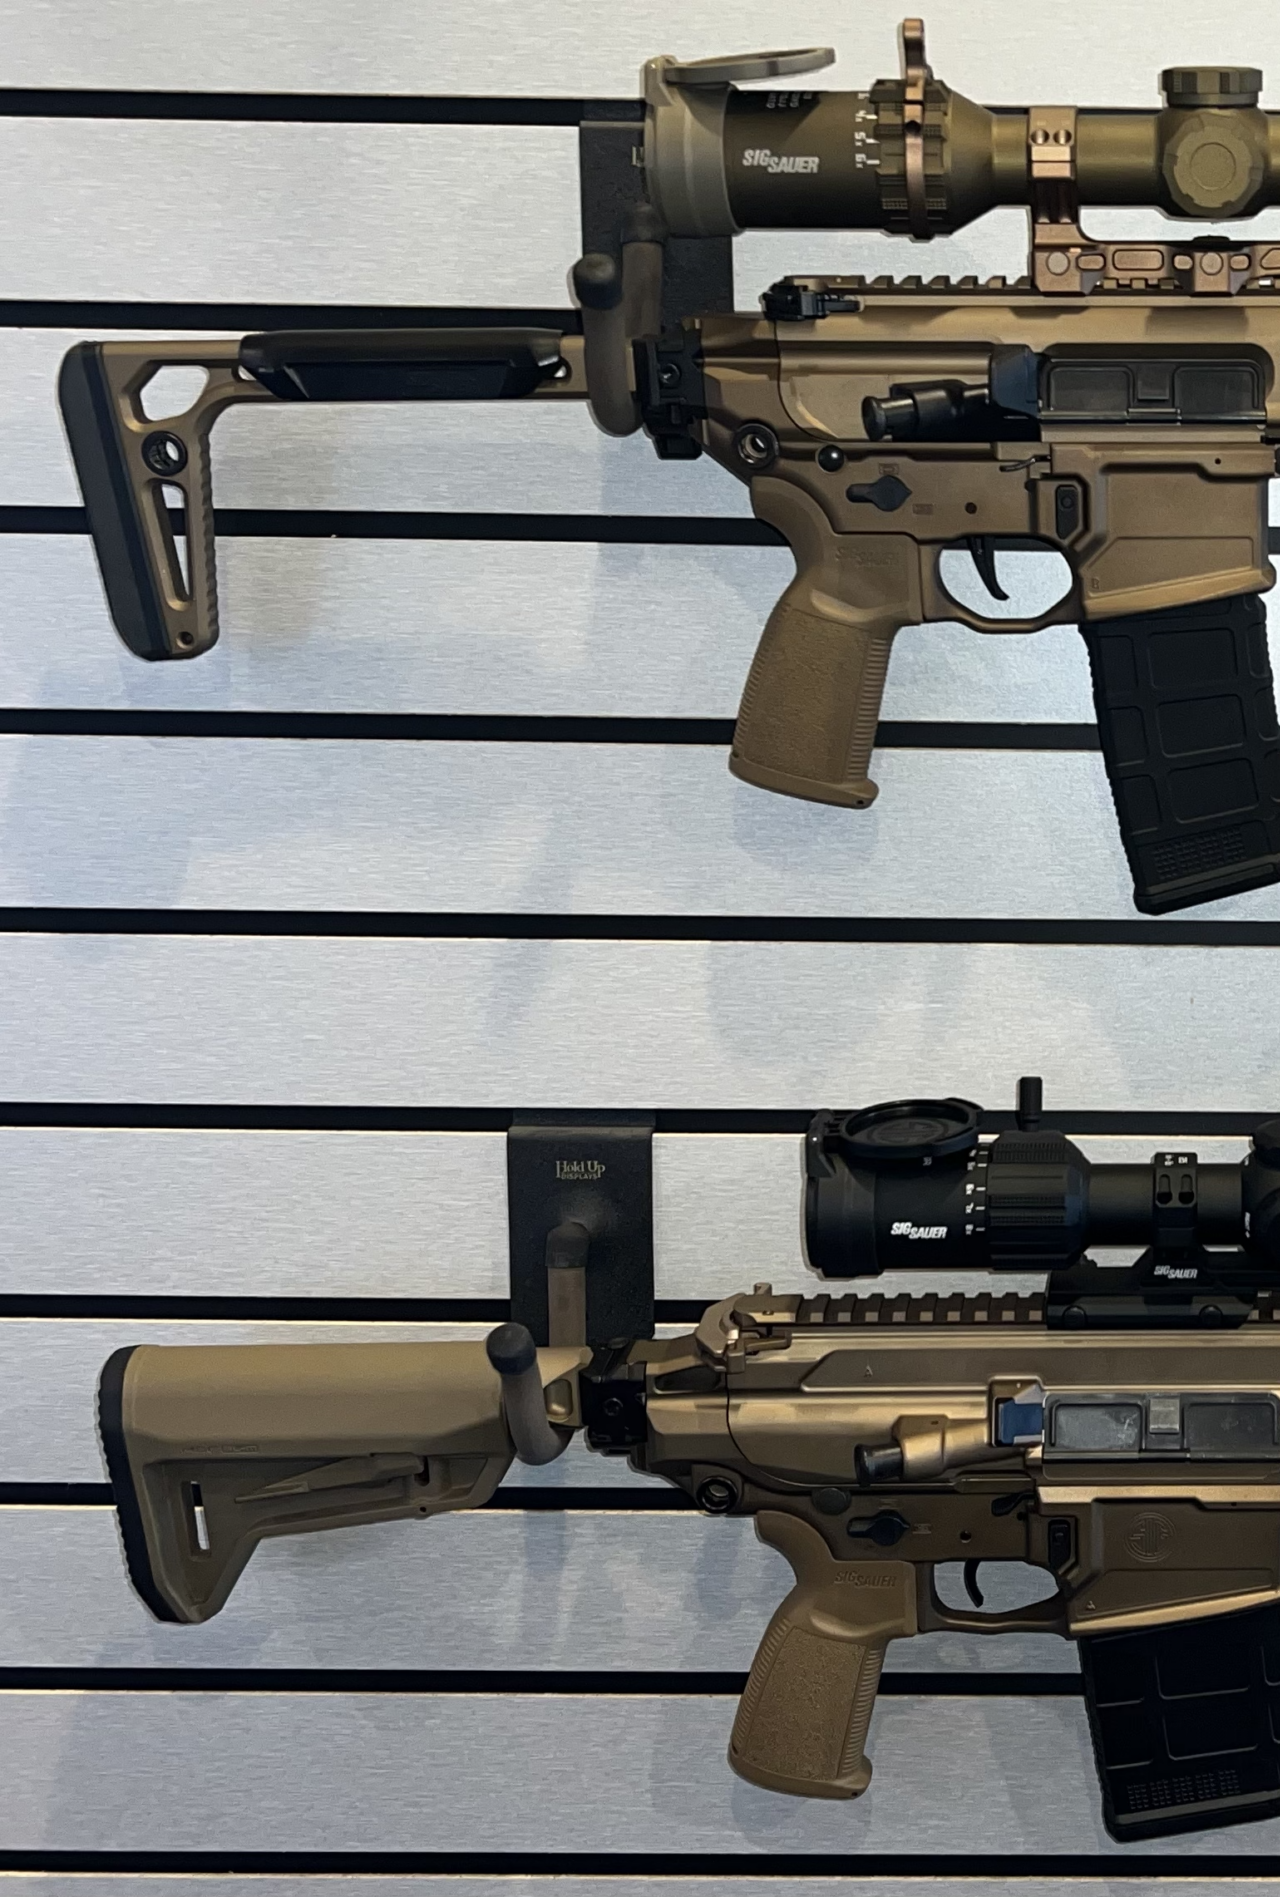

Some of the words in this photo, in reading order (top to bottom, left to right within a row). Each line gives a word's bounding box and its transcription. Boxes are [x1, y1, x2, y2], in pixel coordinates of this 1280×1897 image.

[742, 149, 771, 166] SIG
[767, 156, 820, 173] SAUER
[555, 1161, 584, 1178] Hold
[587, 1161, 605, 1178] Up
[890, 1221, 912, 1235] SIG
[909, 1227, 948, 1239] SAUER
[1154, 1264, 1170, 1275] SIG
[1168, 1268, 1198, 1279] SAUER
[835, 1570, 857, 1583] SIG
[855, 1576, 897, 1588] SAUER
